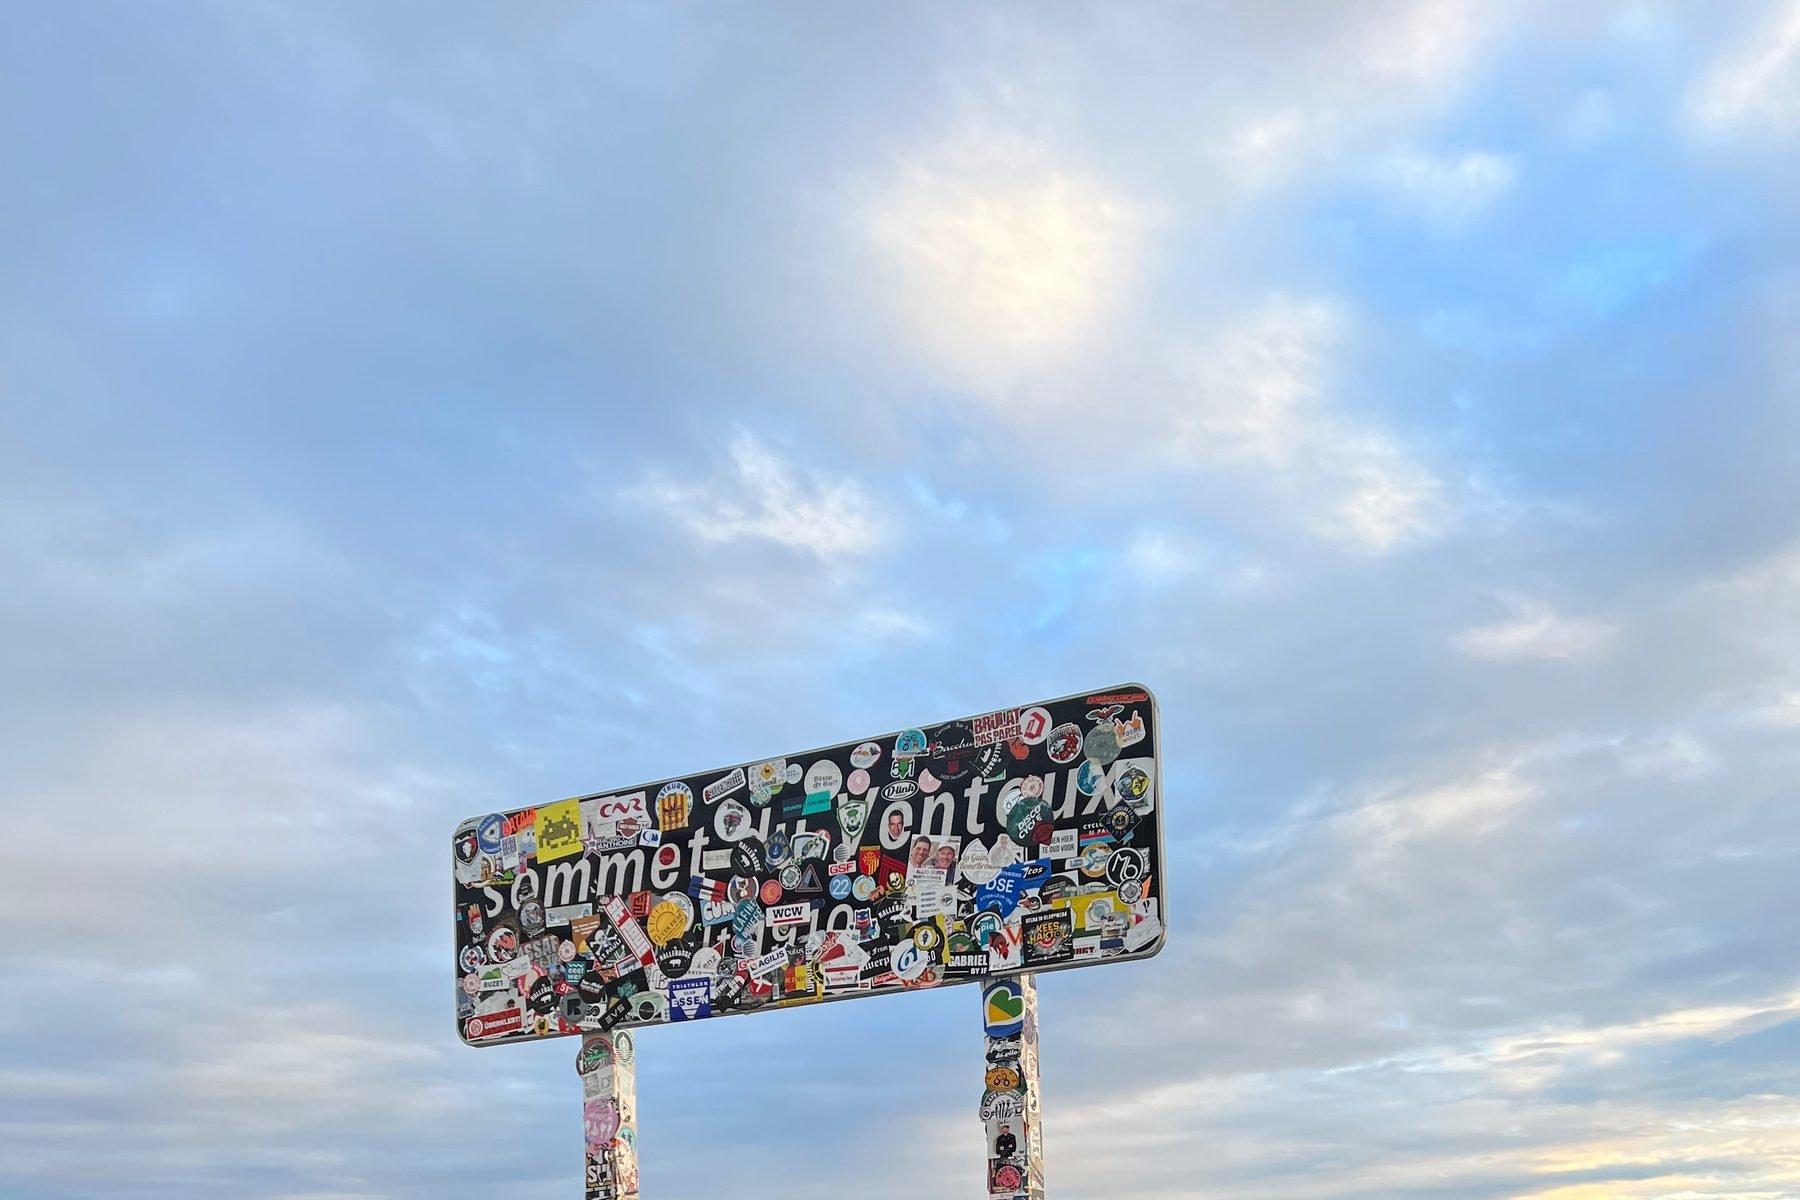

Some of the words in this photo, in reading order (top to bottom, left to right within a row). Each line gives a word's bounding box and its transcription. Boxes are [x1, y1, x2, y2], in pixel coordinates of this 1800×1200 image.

[1018, 805, 1042, 831] DISCO
[1050, 836, 1060, 844] BEN
[1061, 834, 1074, 842] HIER
[1061, 843, 1075, 851] VOOR
[484, 826, 710, 918] sommet
[829, 862, 854, 874] GSF
[832, 878, 848, 896] 22
[772, 906, 803, 919] WCW
[1036, 921, 1060, 932] KEES
[758, 950, 785, 967] AGILIS
[948, 954, 988, 967] GABRIEL
[672, 980, 708, 990] TRIATHLON
[671, 994, 709, 1009] ESSEN
[604, 1003, 626, 1025] EVS
